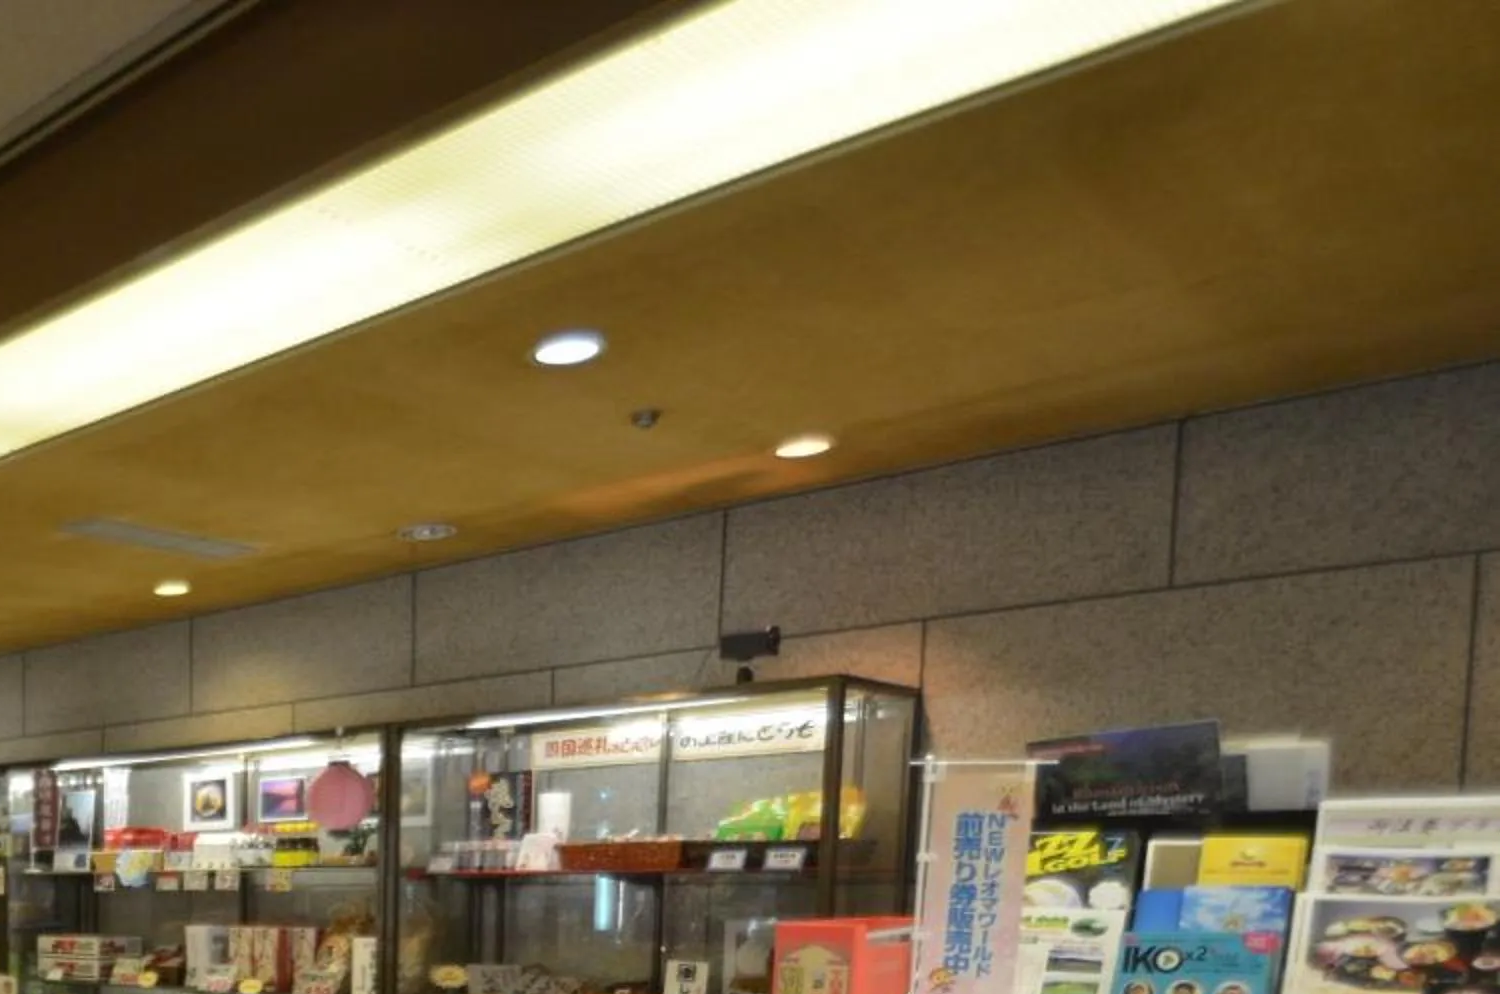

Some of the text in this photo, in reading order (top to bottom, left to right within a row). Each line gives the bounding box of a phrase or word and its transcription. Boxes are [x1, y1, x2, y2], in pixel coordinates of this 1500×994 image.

[943, 812, 986, 975] 前売り券販売中
[975, 813, 1007, 978] NEWレオマワールド
